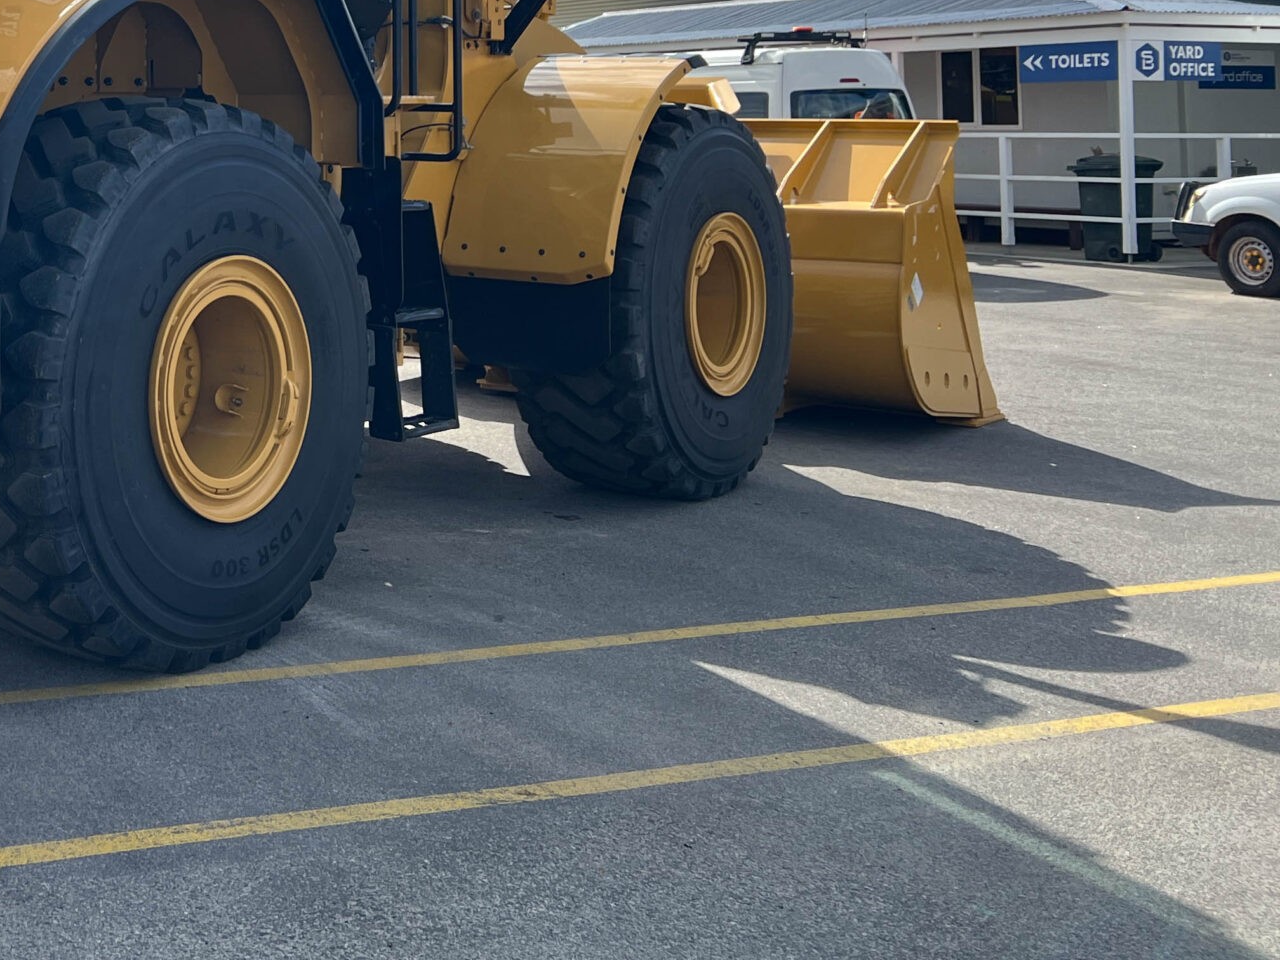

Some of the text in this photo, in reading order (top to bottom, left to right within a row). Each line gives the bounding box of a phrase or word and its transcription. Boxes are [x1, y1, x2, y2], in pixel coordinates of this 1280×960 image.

[1169, 45, 1204, 59] YARD
[1048, 52, 1110, 69] TOILETS
[1169, 62, 1215, 77] OFFICE
